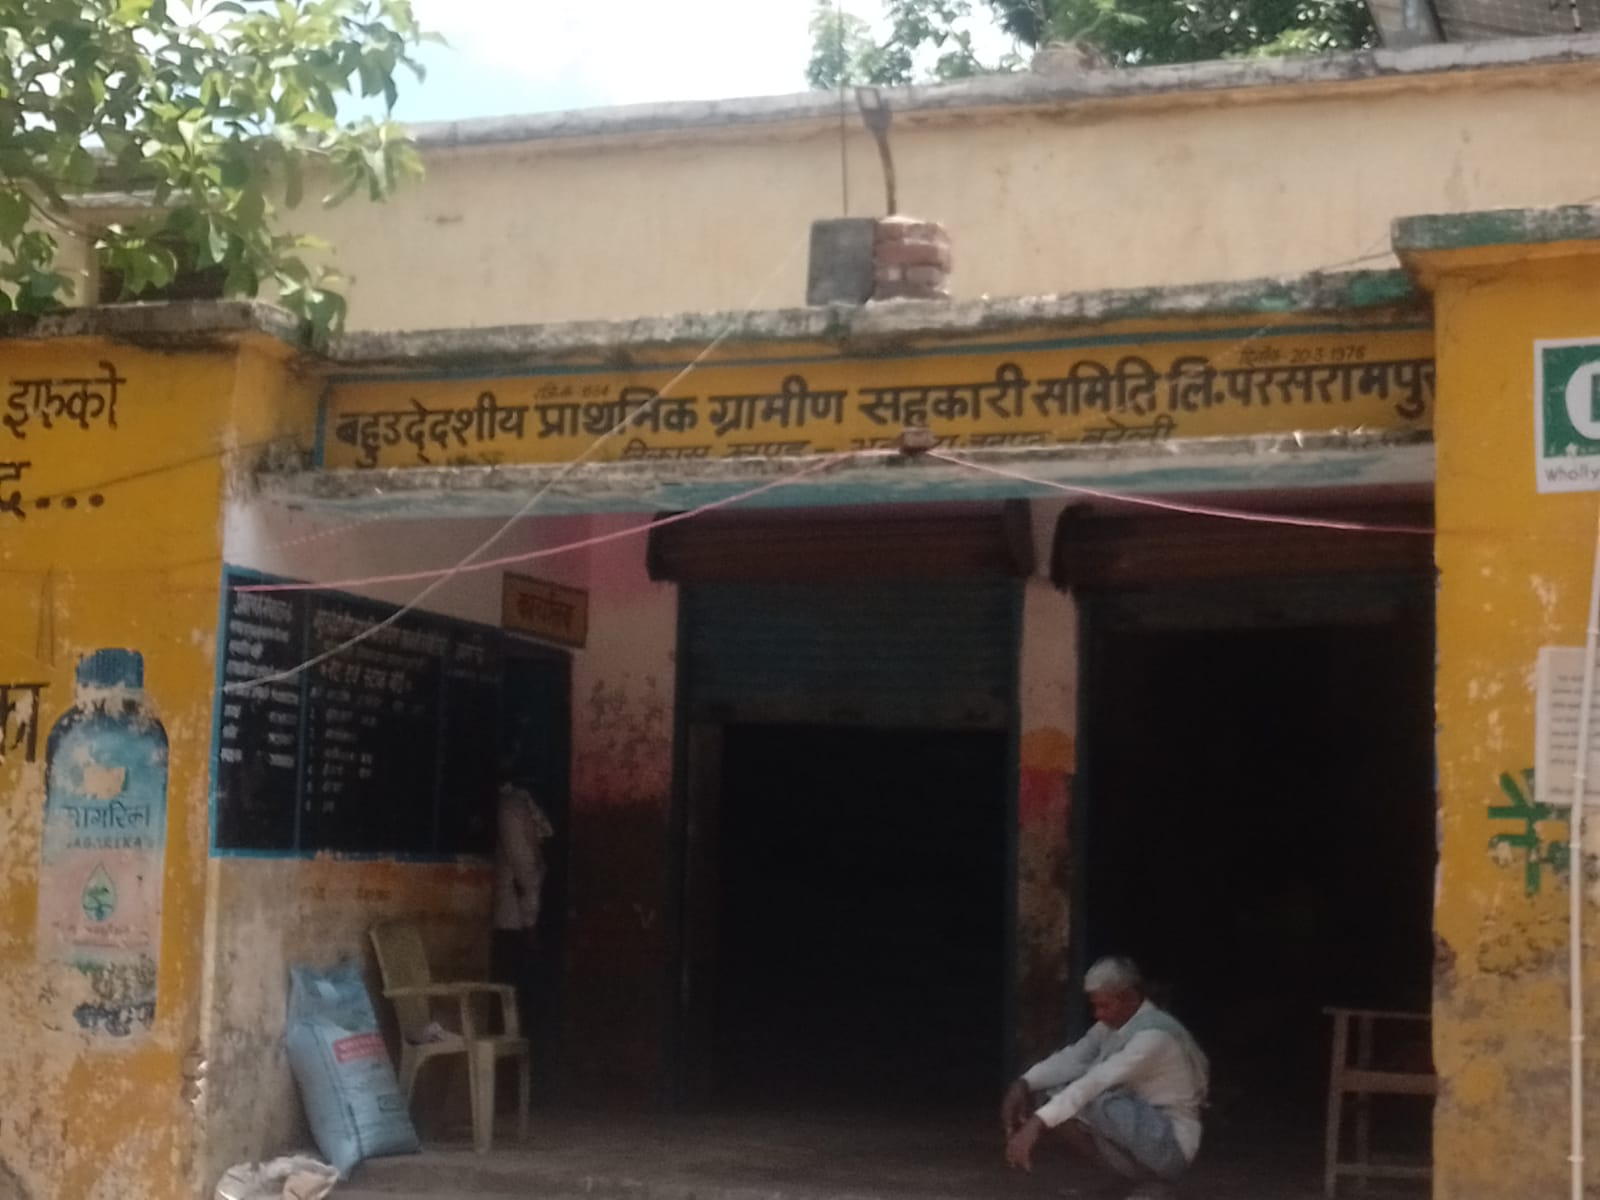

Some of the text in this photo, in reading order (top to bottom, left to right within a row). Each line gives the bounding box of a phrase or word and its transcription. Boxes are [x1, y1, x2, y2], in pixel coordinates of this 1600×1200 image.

[3, 360, 126, 438] इफको
[536, 386, 697, 437] प्राथमिक
[708, 374, 846, 437] ग्रामीण
[859, 362, 1030, 424] सहकारी
[1031, 356, 1159, 417] समिति
